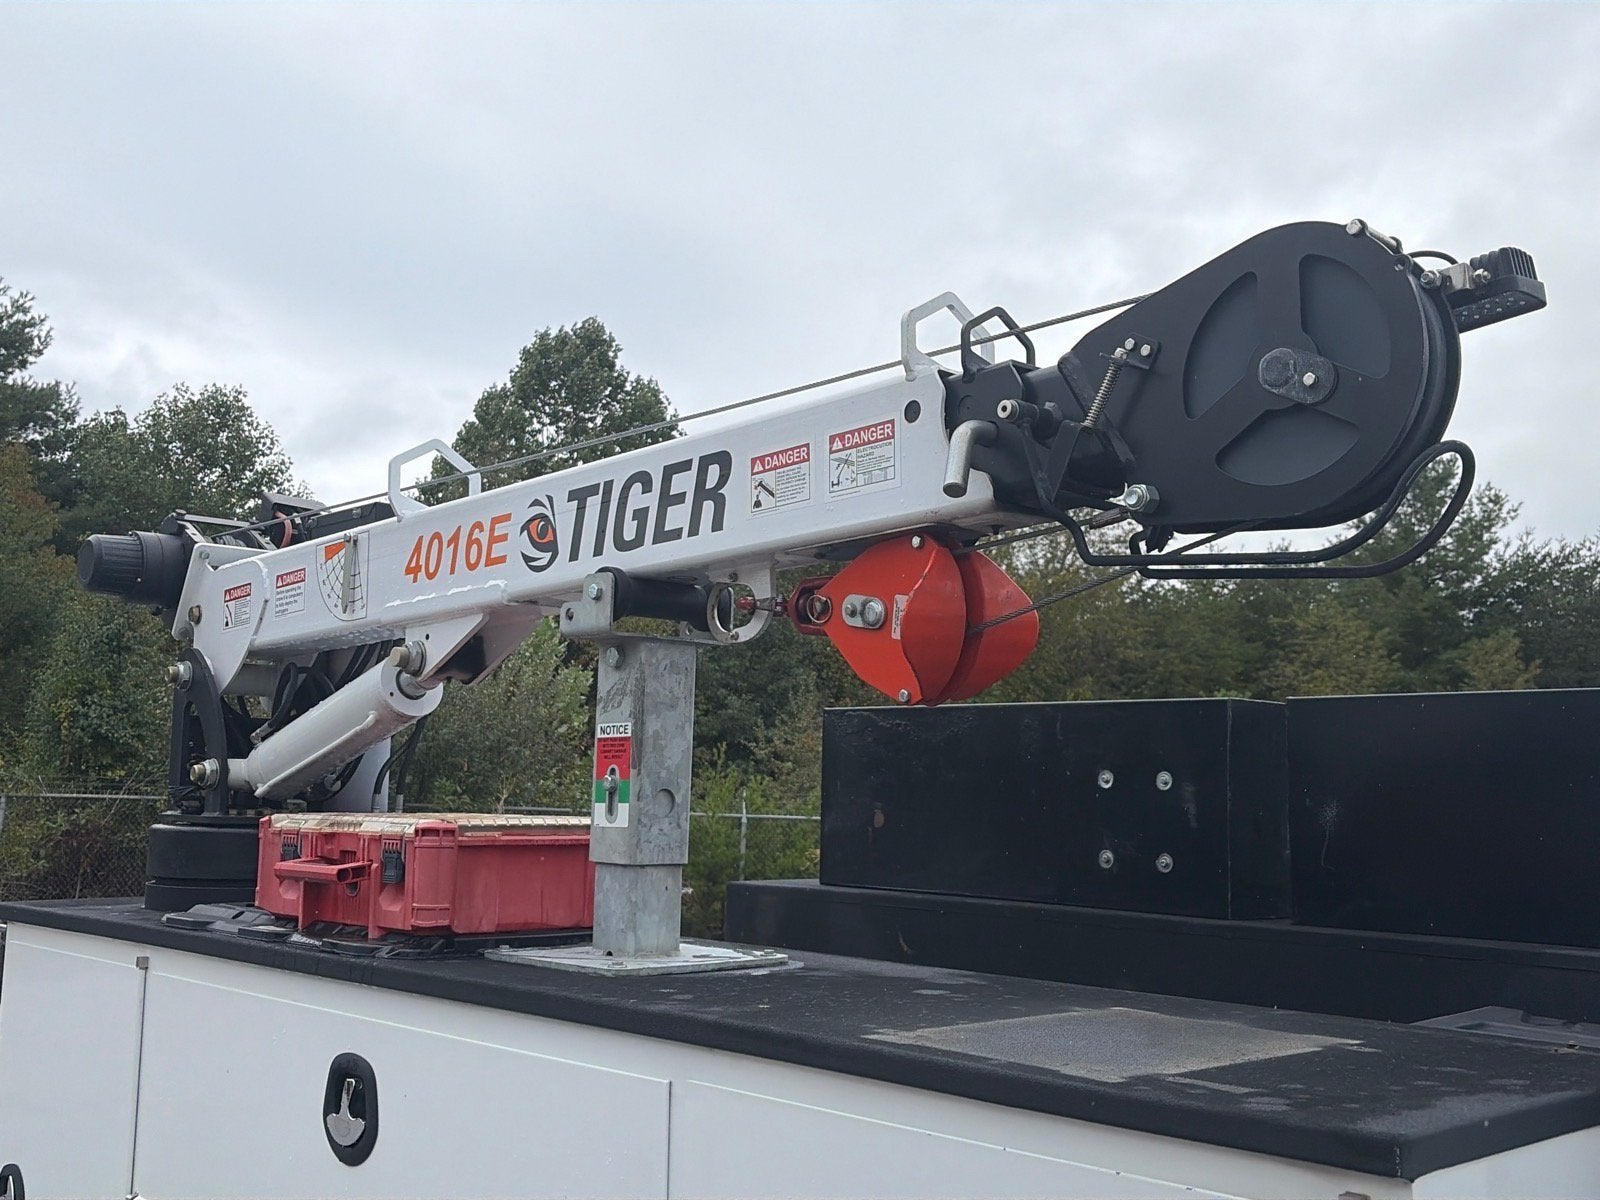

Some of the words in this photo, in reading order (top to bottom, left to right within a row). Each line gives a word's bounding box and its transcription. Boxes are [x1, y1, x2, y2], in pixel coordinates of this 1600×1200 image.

[844, 423, 893, 447] DANGER
[764, 446, 808, 470] DANGER
[404, 512, 512, 584] 4016E
[567, 450, 733, 563] TIGER
[282, 570, 305, 585] DANGER
[230, 585, 251, 599] DANGER
[600, 724, 629, 736] NOTICE
